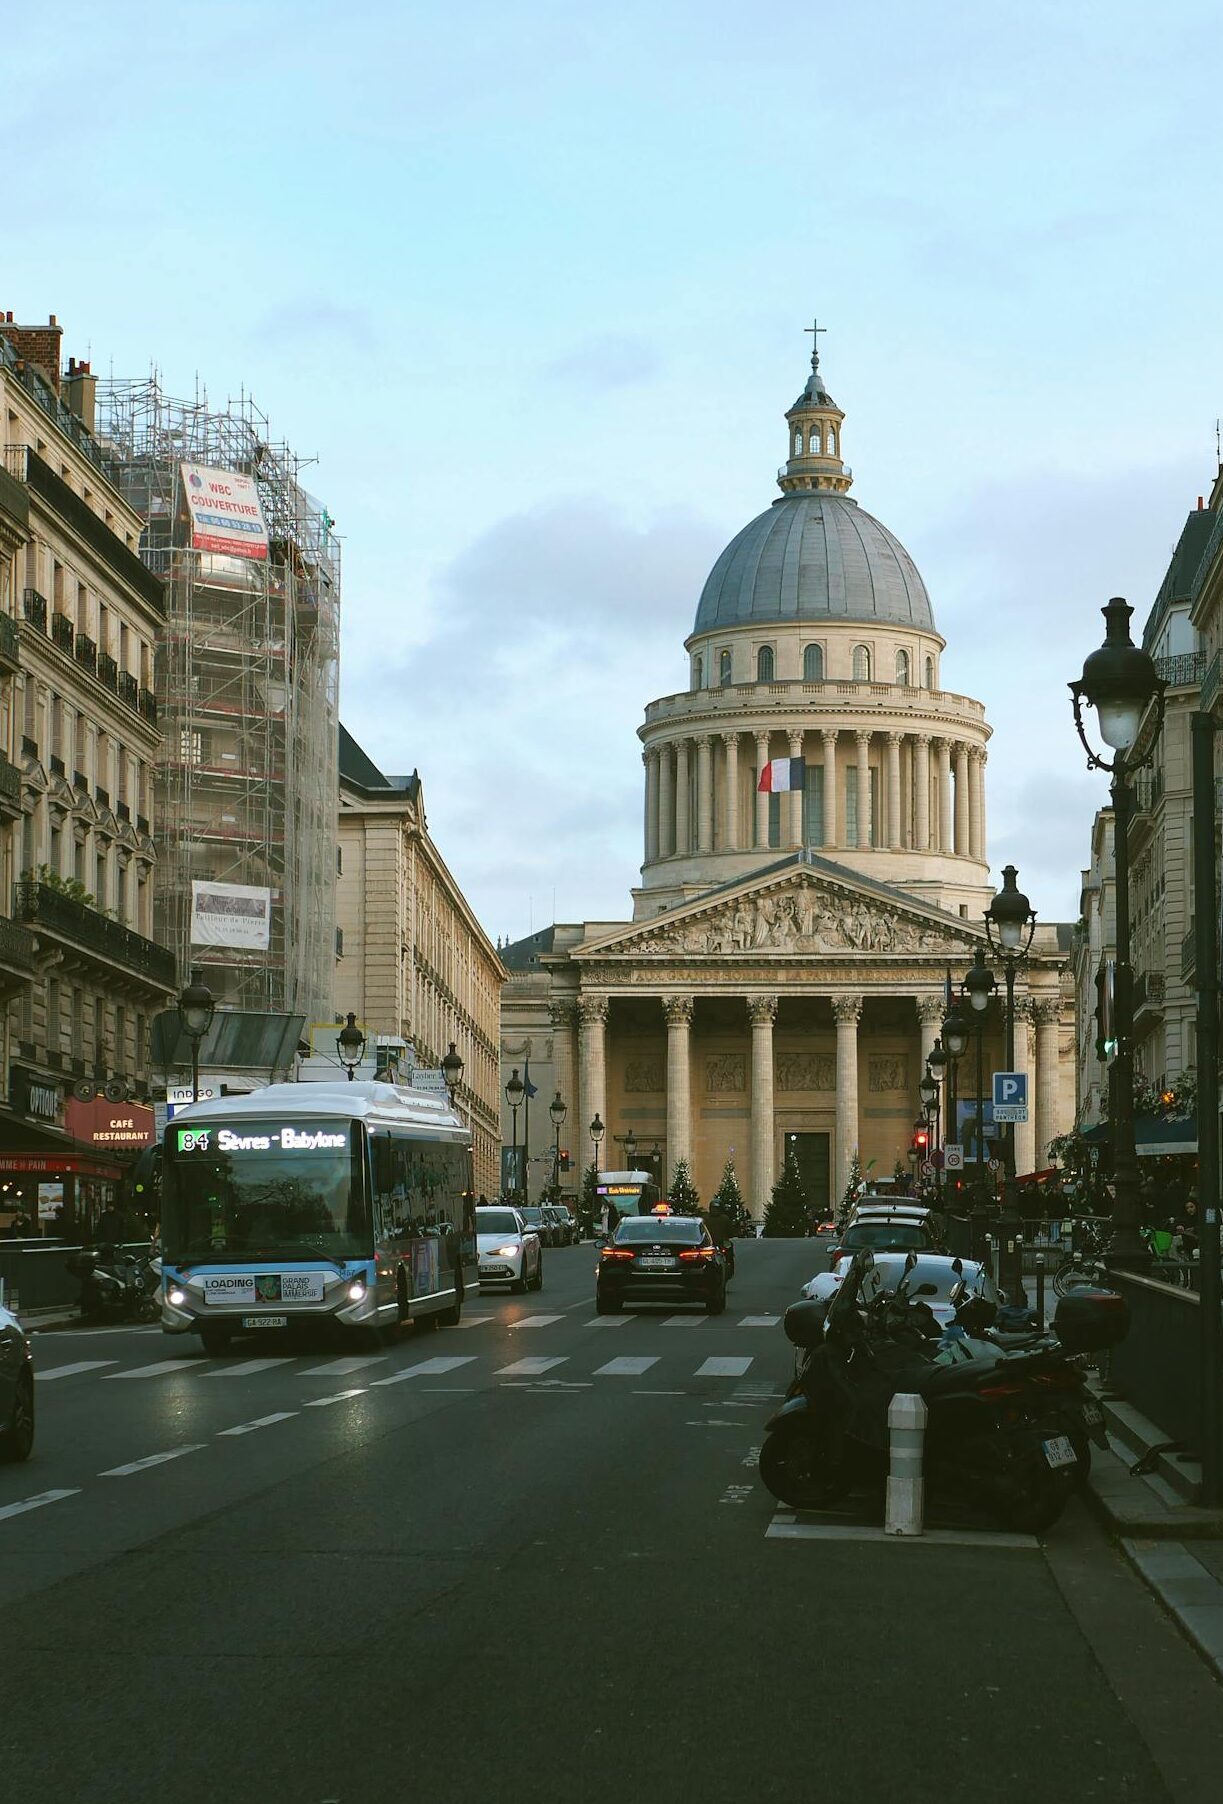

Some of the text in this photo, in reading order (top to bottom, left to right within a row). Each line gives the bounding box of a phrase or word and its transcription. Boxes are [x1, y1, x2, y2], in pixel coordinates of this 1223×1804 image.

[208, 483, 232, 495] WBC
[191, 494, 258, 516] COUVERTURE
[173, 1088, 213, 1099] INDGO
[1002, 1079, 1018, 1101] P
[110, 1118, 134, 1129] CAFÉ
[93, 1132, 149, 1141] RESTAURANT
[185, 1133, 209, 1151] 84
[281, 1128, 346, 1150] Babylone
[28, 1160, 46, 1170] PAIN
[205, 1278, 254, 1289] LOADING
[282, 1283, 309, 1291] PALAIS
